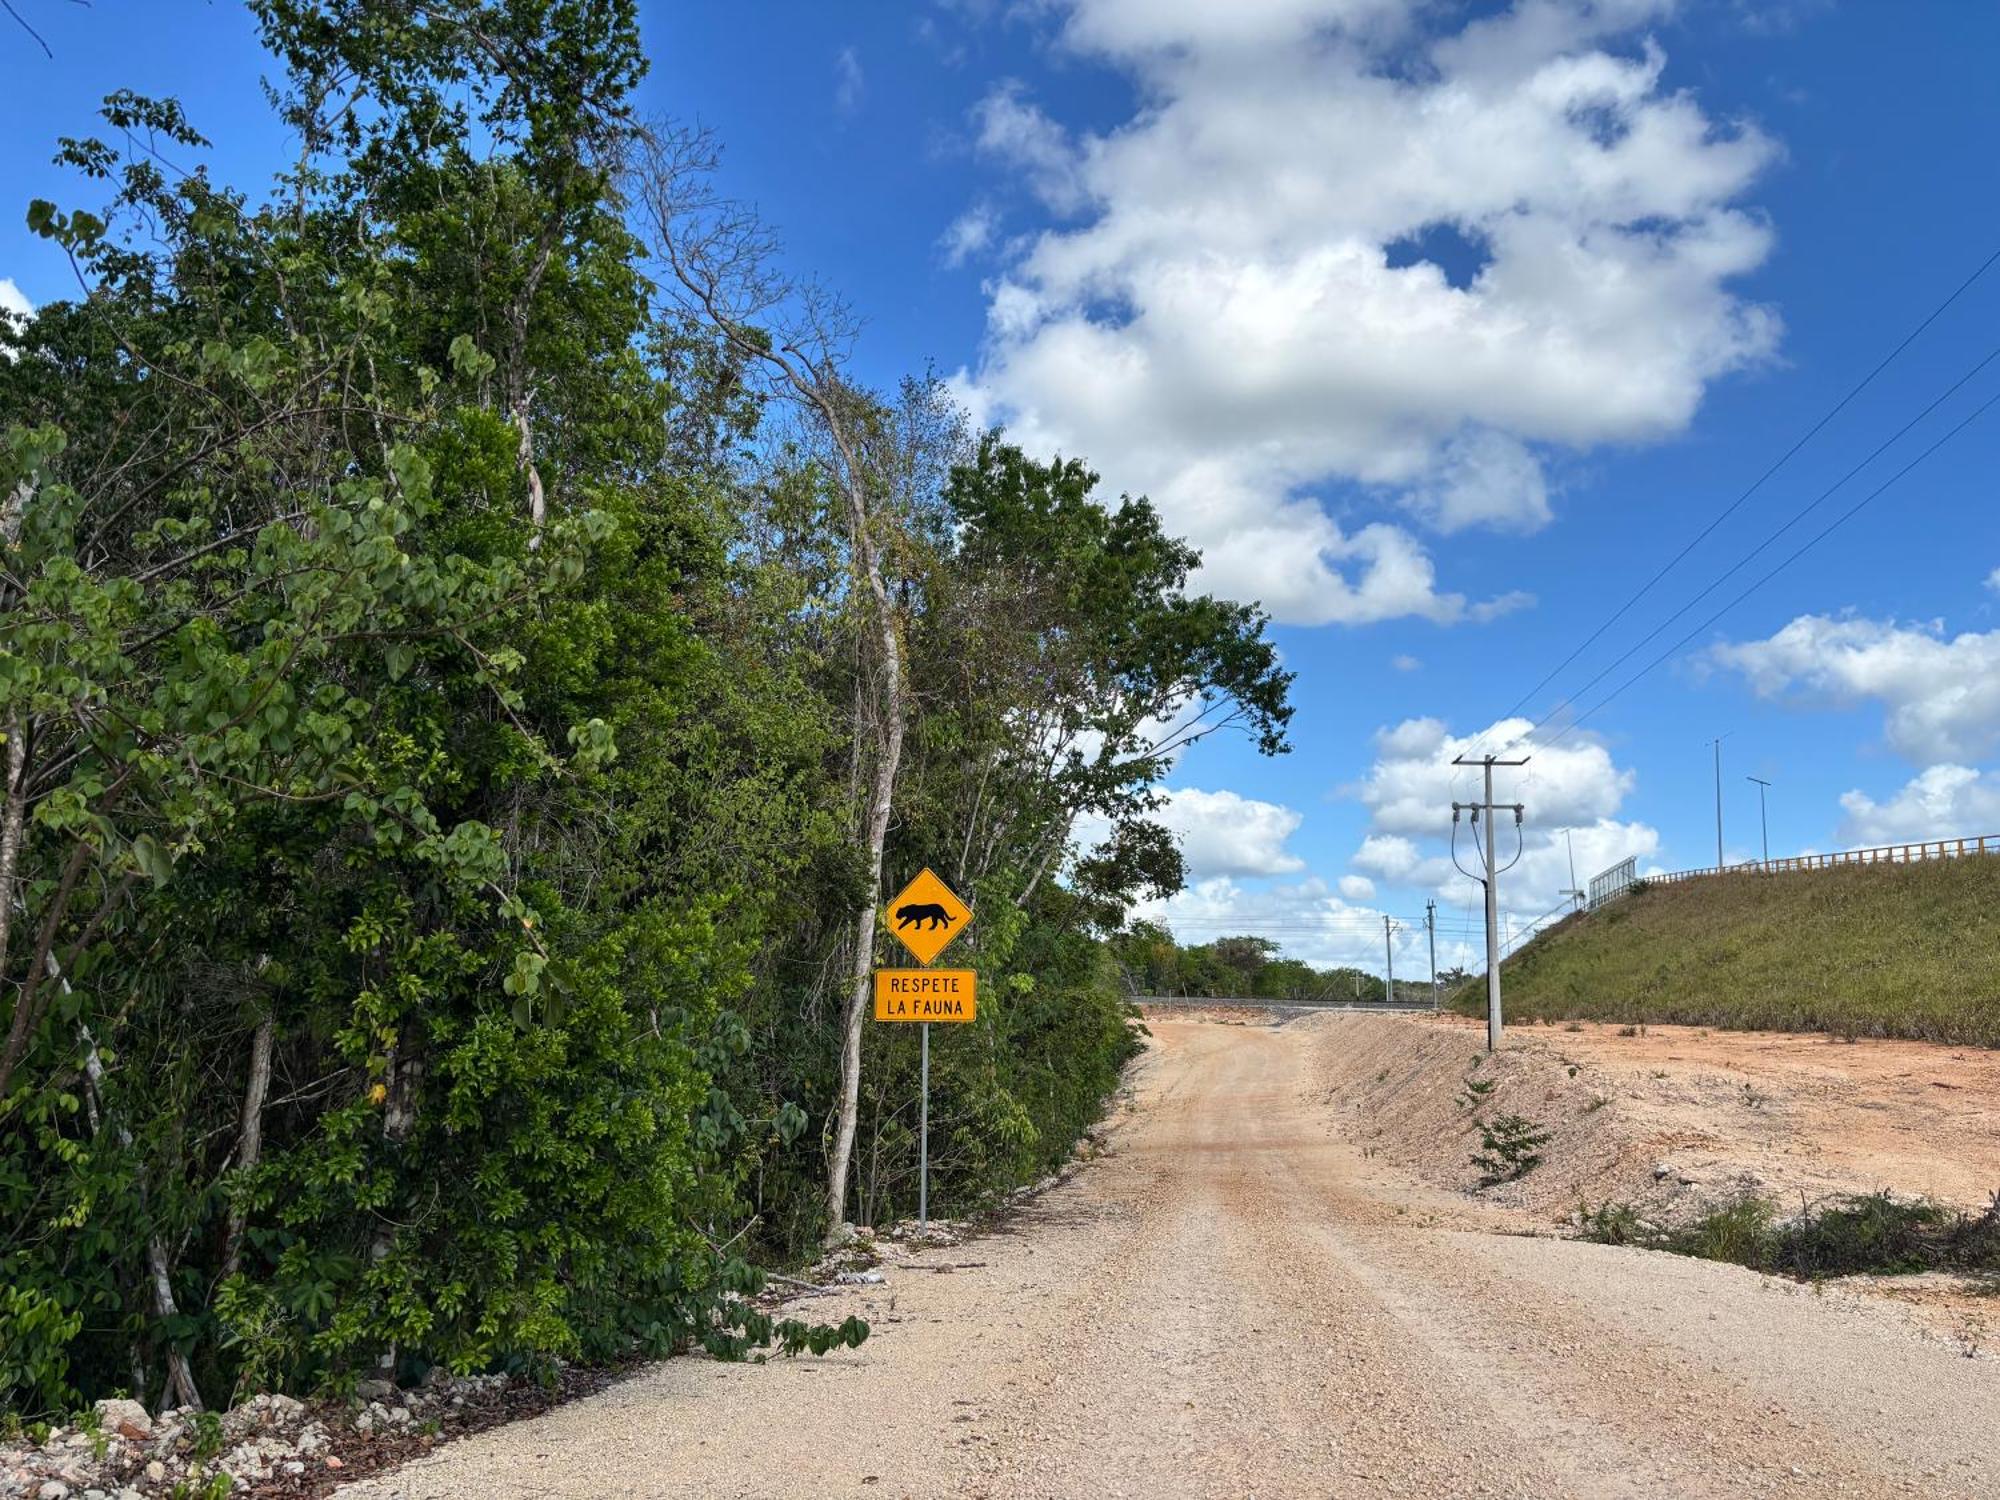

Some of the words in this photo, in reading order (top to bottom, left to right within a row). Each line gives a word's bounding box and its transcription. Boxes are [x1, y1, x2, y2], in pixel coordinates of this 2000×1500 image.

[891, 978, 959, 993] RESPETE
[887, 1000, 906, 1015] LA
[913, 1000, 963, 1015] FAUNA
